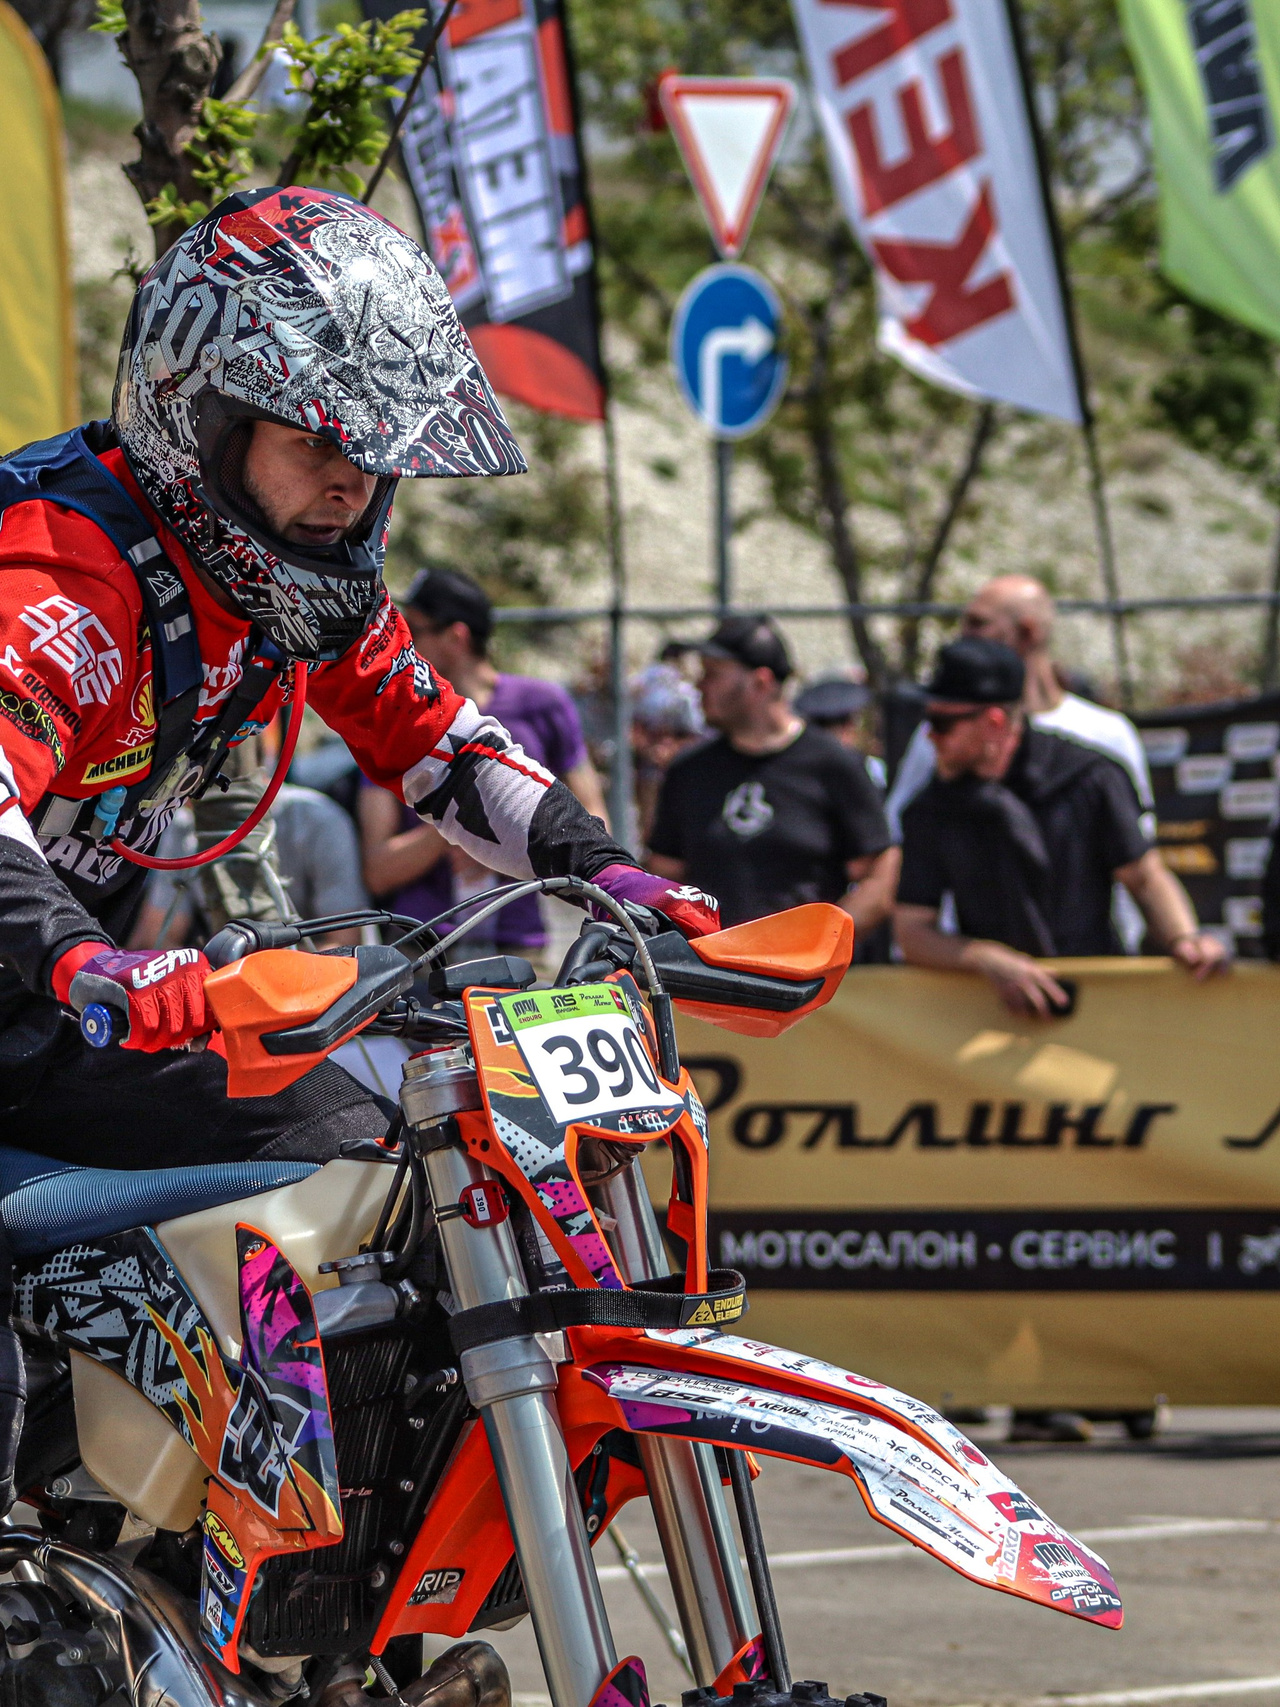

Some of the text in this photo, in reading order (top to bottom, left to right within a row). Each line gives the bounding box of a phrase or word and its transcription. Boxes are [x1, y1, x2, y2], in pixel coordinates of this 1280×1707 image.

[541, 1027, 661, 1105] 390
[476, 1196, 486, 1213] 390
[720, 1230, 1177, 1270] МОТОСАЛОН СЕРВИС
[760, 1401, 809, 1418] KENDA
[823, 1427, 856, 1441] АРЕНА
[910, 1454, 975, 1501] ФОРСАЖ
[206, 1513, 244, 1564] FMF
[414, 1571, 460, 1593] RIP
[1051, 1569, 1091, 1581] ENDURO
[1051, 1582, 1102, 1601] ДРУГОЙ
[1073, 1594, 1121, 1609] ПУТЬ
